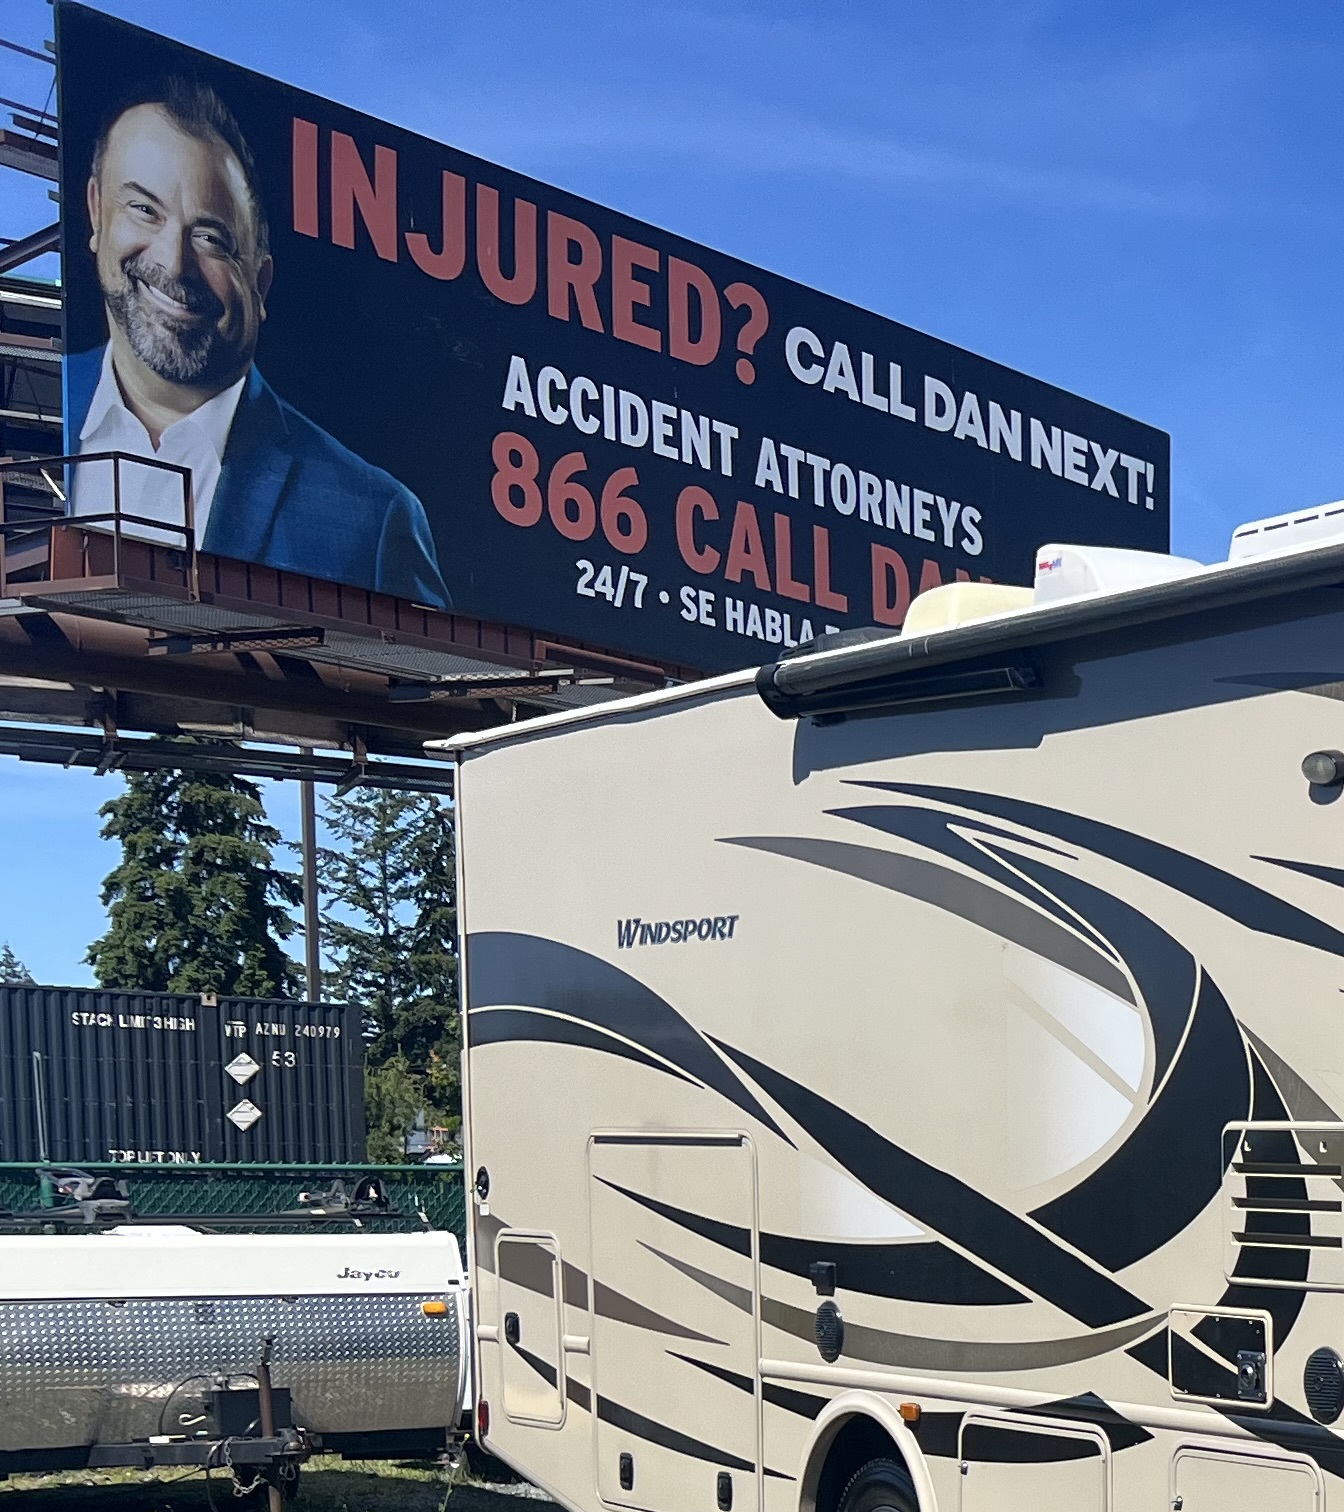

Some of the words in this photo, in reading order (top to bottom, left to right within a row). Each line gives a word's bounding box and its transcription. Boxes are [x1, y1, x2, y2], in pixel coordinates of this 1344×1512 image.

[292, 116, 770, 386] INJURED?
[501, 354, 739, 477] ACCIDENT
[755, 436, 985, 556] ATTORNEYS
[785, 326, 917, 424] CALL
[923, 374, 1023, 462] DAN
[1030, 410, 1156, 511] NEXT!
[490, 431, 649, 555] 866
[675, 485, 849, 614] CALL
[575, 559, 648, 609] 24/7
[679, 585, 717, 628] SE
[724, 596, 815, 648] HABLA
[153, 1016, 162, 1030] 3
[163, 1016, 196, 1031] HIGH
[255, 1022, 286, 1036] AZNU
[294, 1024, 341, 1039] 240979
[271, 1050, 297, 1068] 53
[336, 1266, 401, 1282] Jayco
